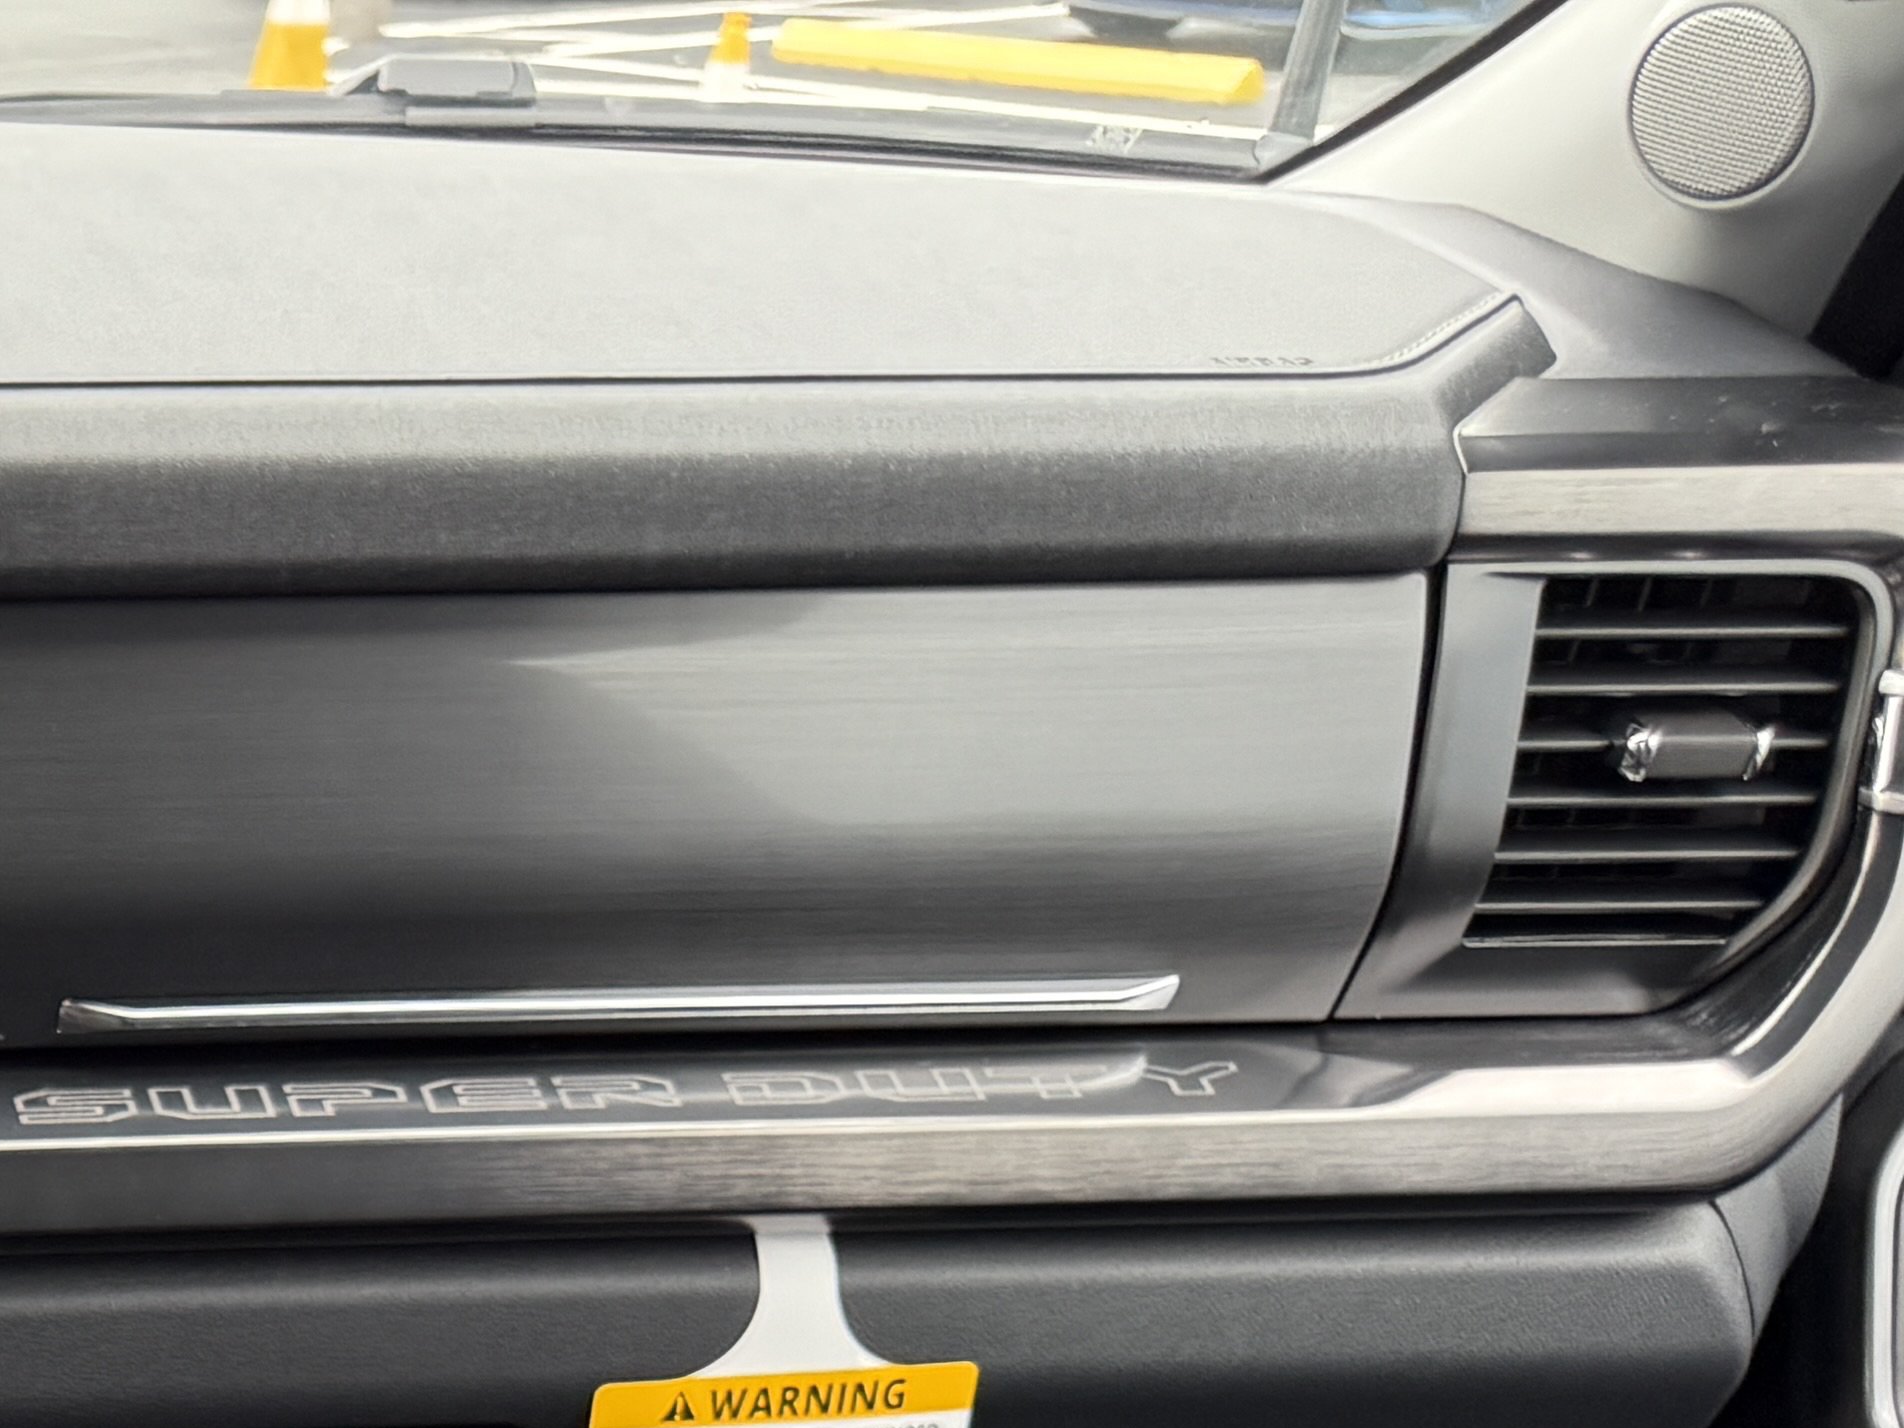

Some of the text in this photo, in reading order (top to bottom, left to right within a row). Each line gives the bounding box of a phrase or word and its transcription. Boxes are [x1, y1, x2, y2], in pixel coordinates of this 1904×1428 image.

[13, 1059, 1240, 1127] SUPER DUTY
[711, 1379, 907, 1421] WARNING
